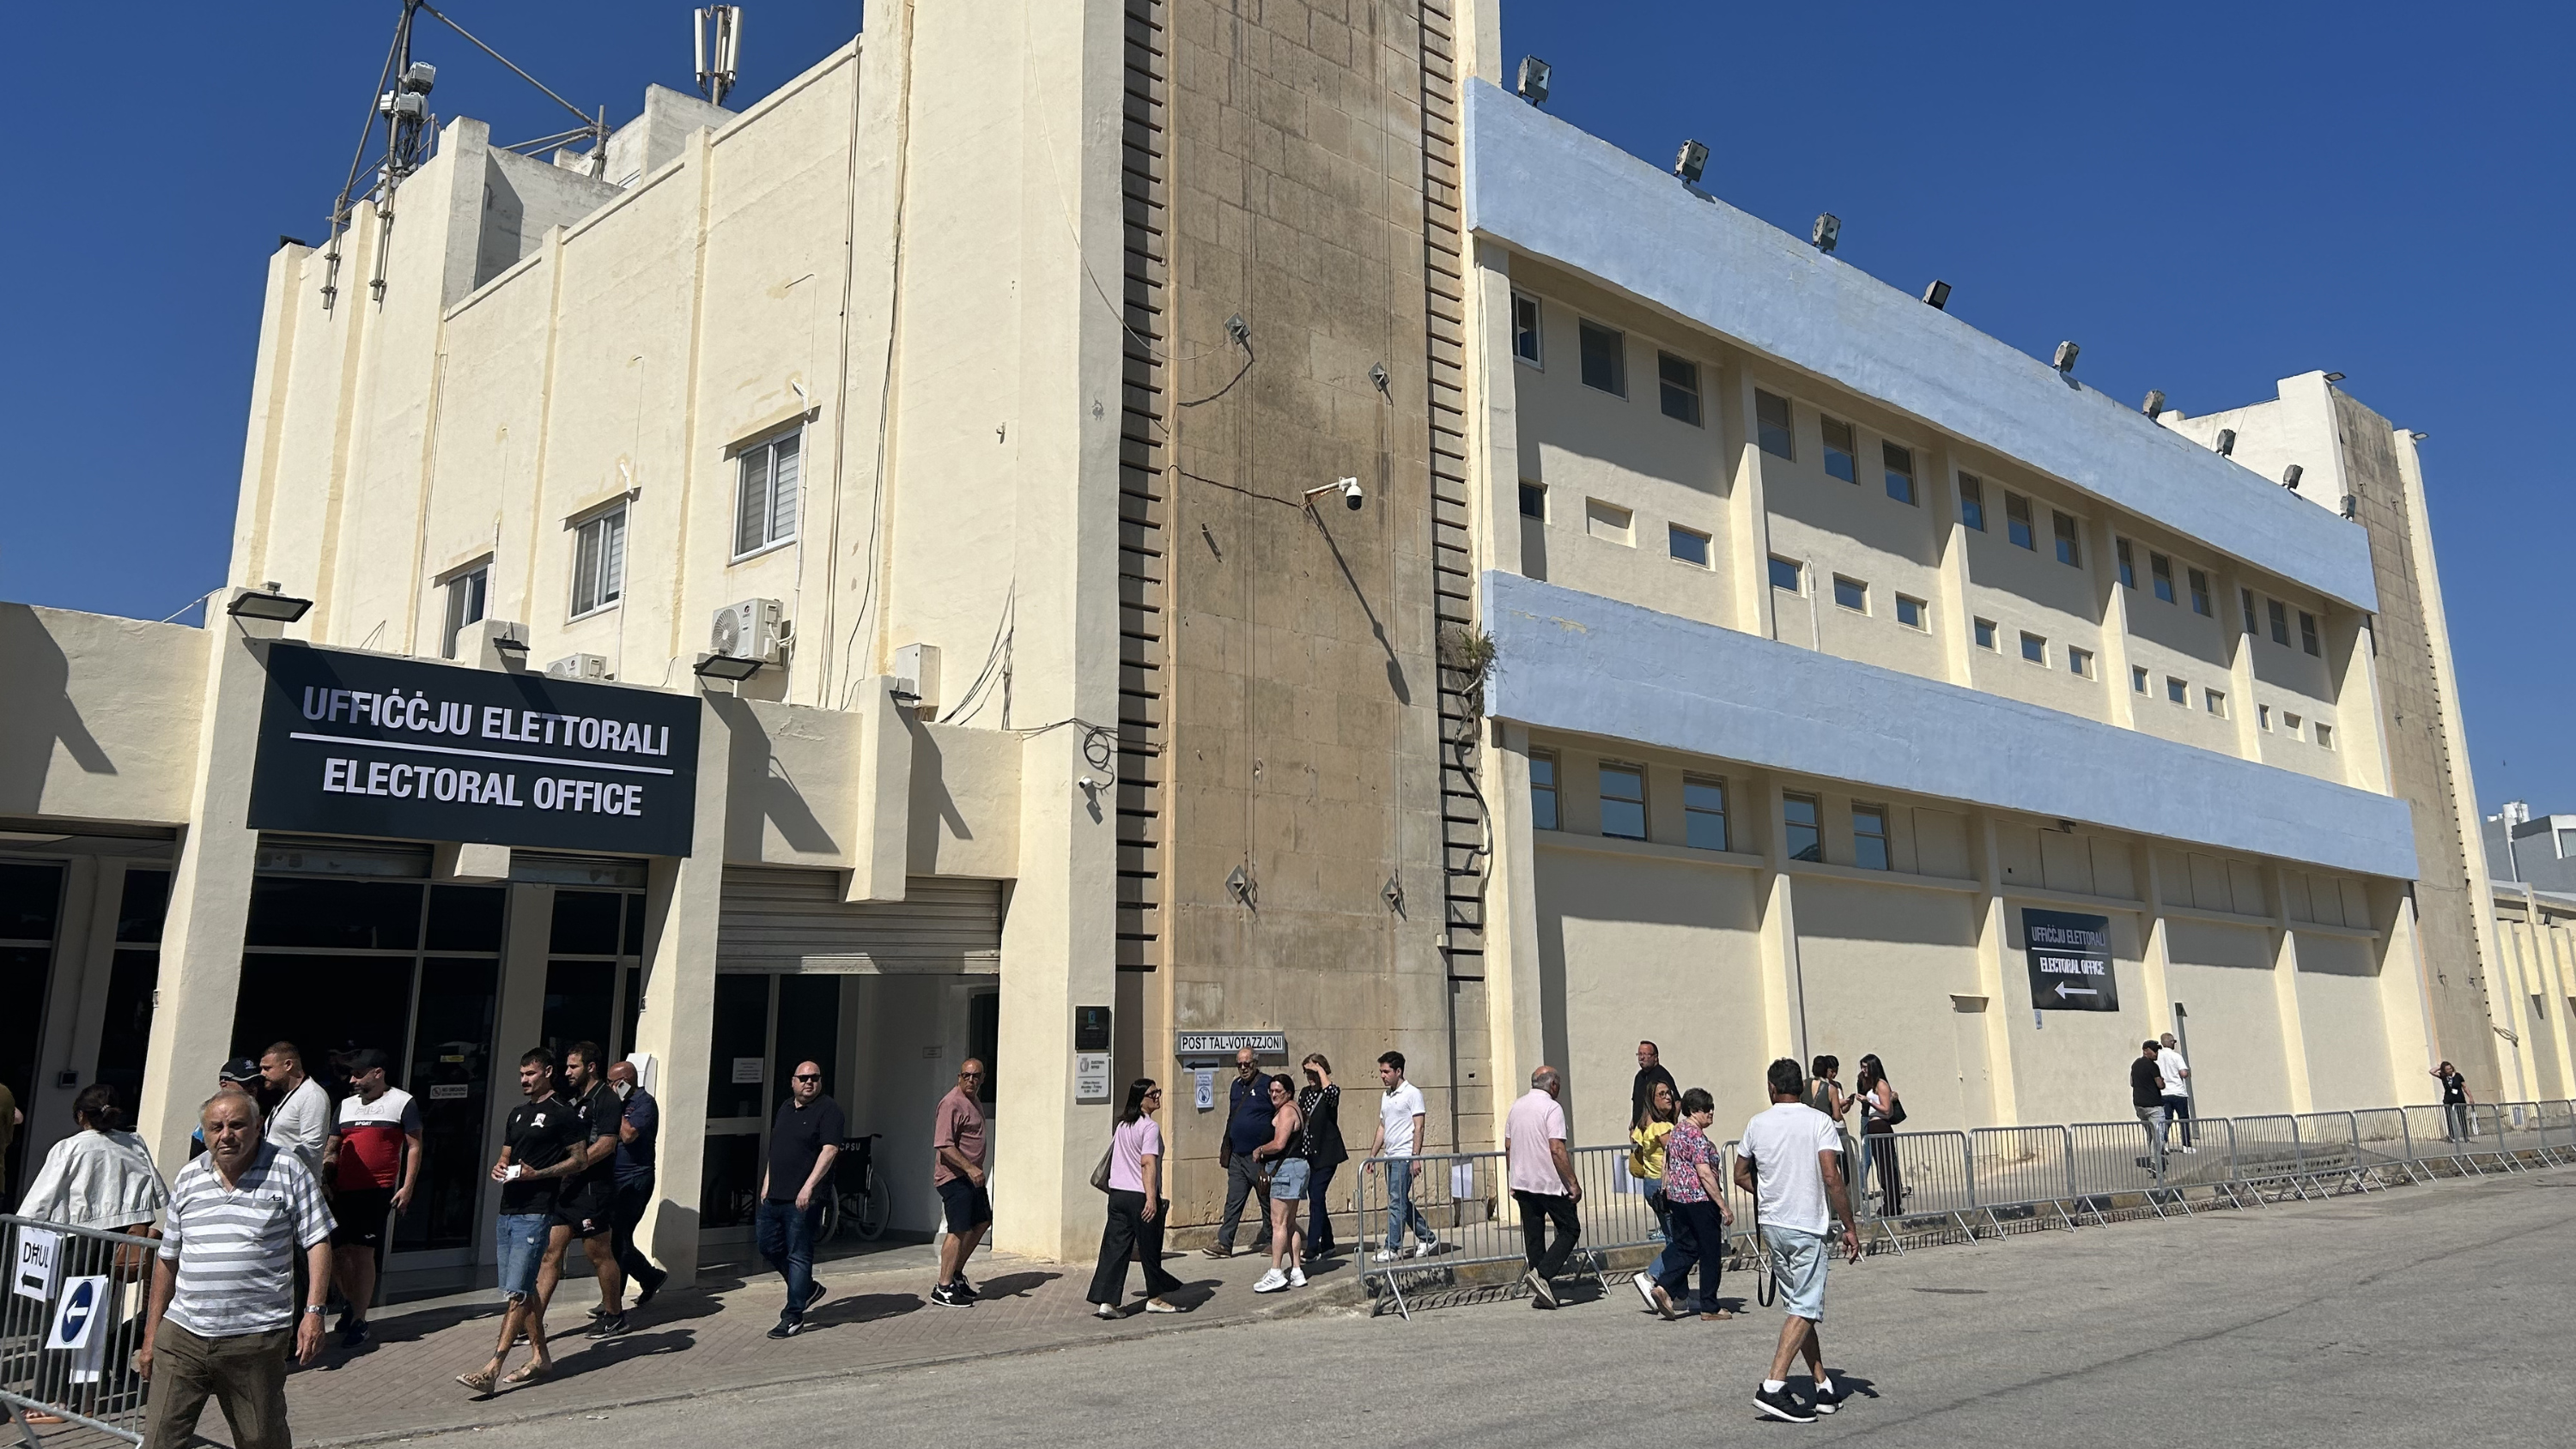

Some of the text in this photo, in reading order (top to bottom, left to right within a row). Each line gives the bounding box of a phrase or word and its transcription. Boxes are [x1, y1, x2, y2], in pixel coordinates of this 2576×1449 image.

[303, 685, 670, 756] UFFIĊĊJU ELETTORALI
[323, 757, 642, 816] ELECTORAL OFFICE
[2032, 925, 2105, 947] UFFIĊĊJU ELETTORALI
[2039, 956, 2105, 975] ELECTORAL OFFICE
[1182, 1036, 1282, 1049] POST TAL-VOTAZZJONI
[355, 1105, 385, 1116] FILA
[23, 1241, 49, 1269] DĦUL
